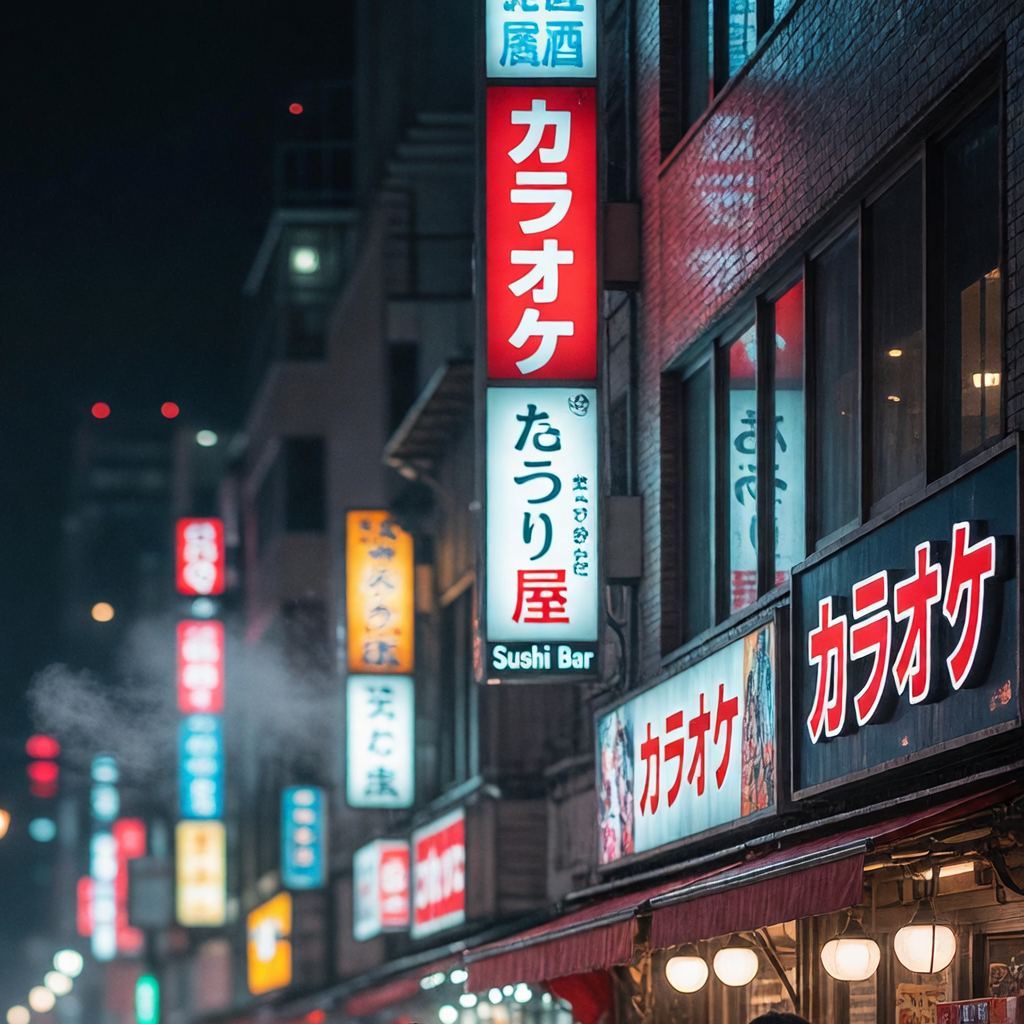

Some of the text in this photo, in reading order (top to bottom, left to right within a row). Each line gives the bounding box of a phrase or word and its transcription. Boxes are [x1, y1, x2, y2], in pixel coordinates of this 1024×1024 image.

[508, 99, 574, 375] カラオケ
[492, 644, 594, 670] Sushi Bar
[807, 521, 997, 745] カラオケ
[639, 683, 740, 817] カラオケ
